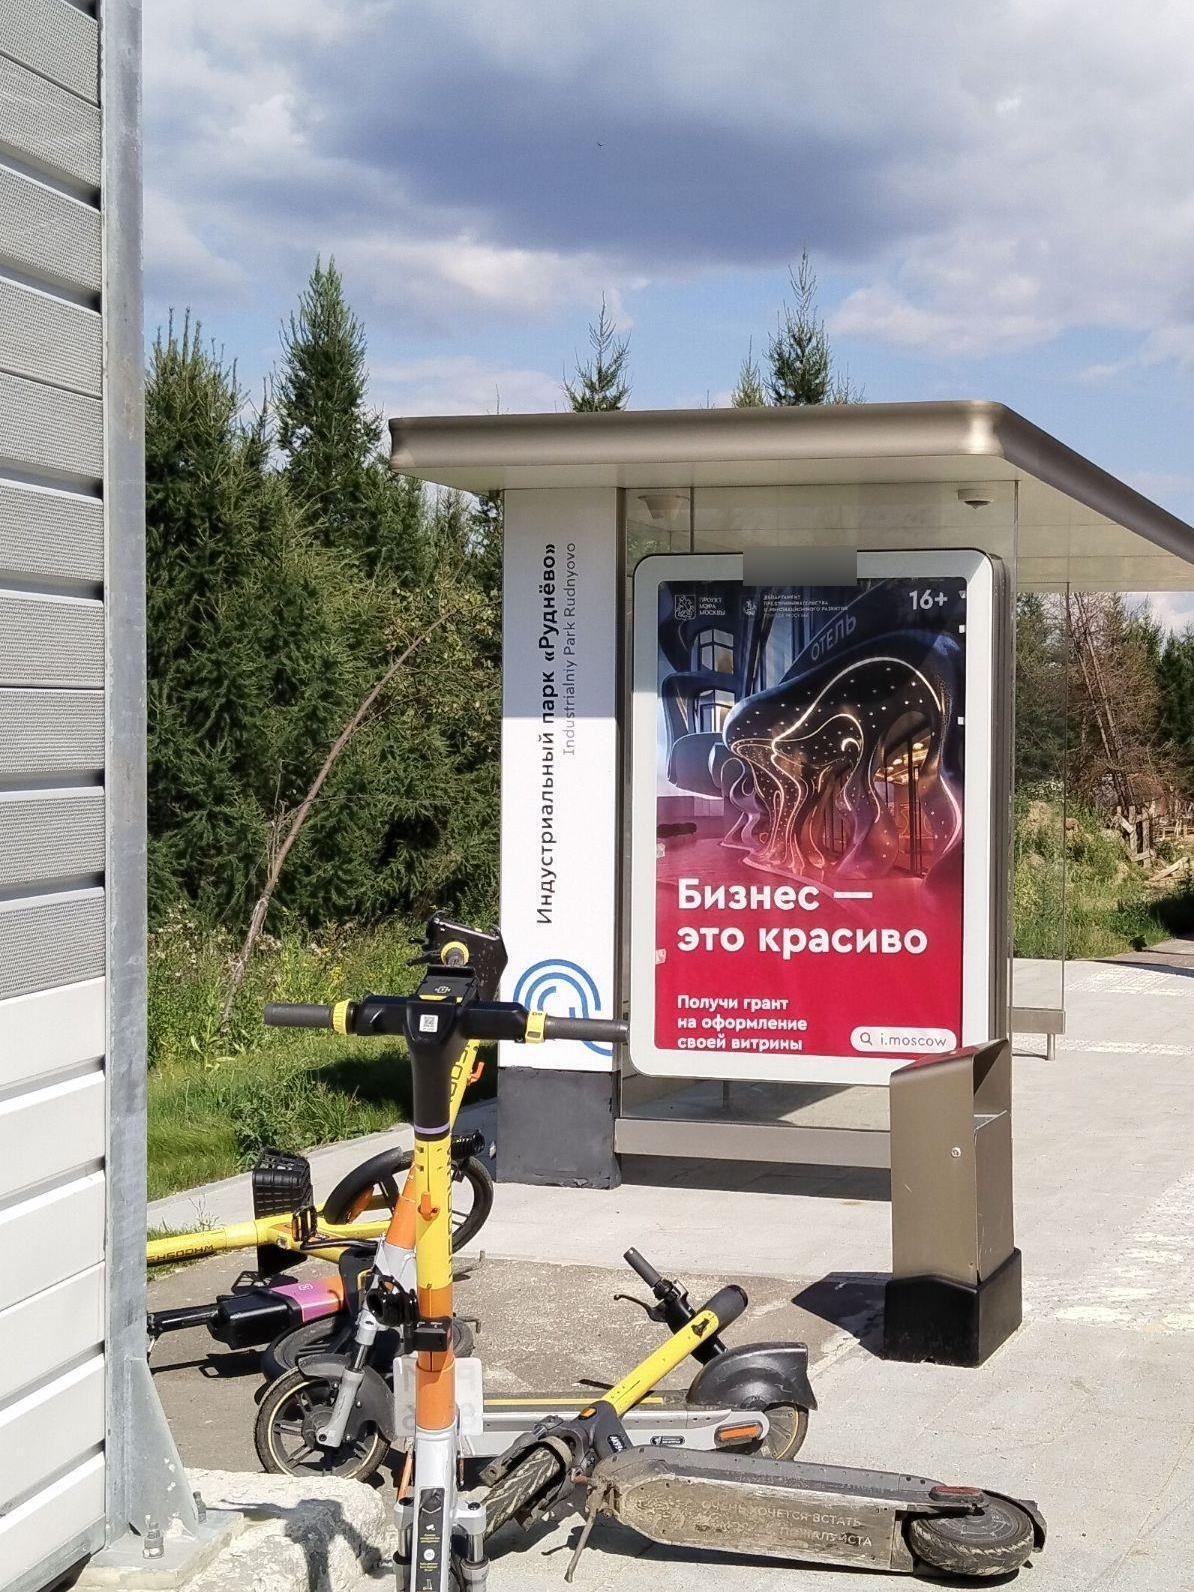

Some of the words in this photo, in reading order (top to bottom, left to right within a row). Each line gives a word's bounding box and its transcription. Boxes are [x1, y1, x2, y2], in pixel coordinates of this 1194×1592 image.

[563, 543, 579, 617] Rudnyovo
[538, 543, 560, 662] «Руднёво»
[909, 589, 948, 610] 16+
[563, 621, 576, 655] Park
[810, 613, 857, 662] ОТЕЛЬ
[542, 671, 559, 723] парк
[562, 660, 578, 756] Industrialniy
[537, 732, 557, 924] Индустриальный
[677, 877, 820, 911] Бизнес
[677, 926, 745, 951] это
[759, 927, 928, 959] красиво
[677, 994, 738, 1011] Получи
[743, 997, 789, 1012] грант
[677, 1016, 697, 1029] на
[701, 1015, 808, 1032] оформление
[880, 1033, 948, 1047] i.moscow
[677, 1034, 726, 1049] своей
[731, 1038, 803, 1051] витрины
[813, 1513, 863, 1528] ВСТАТЬ
